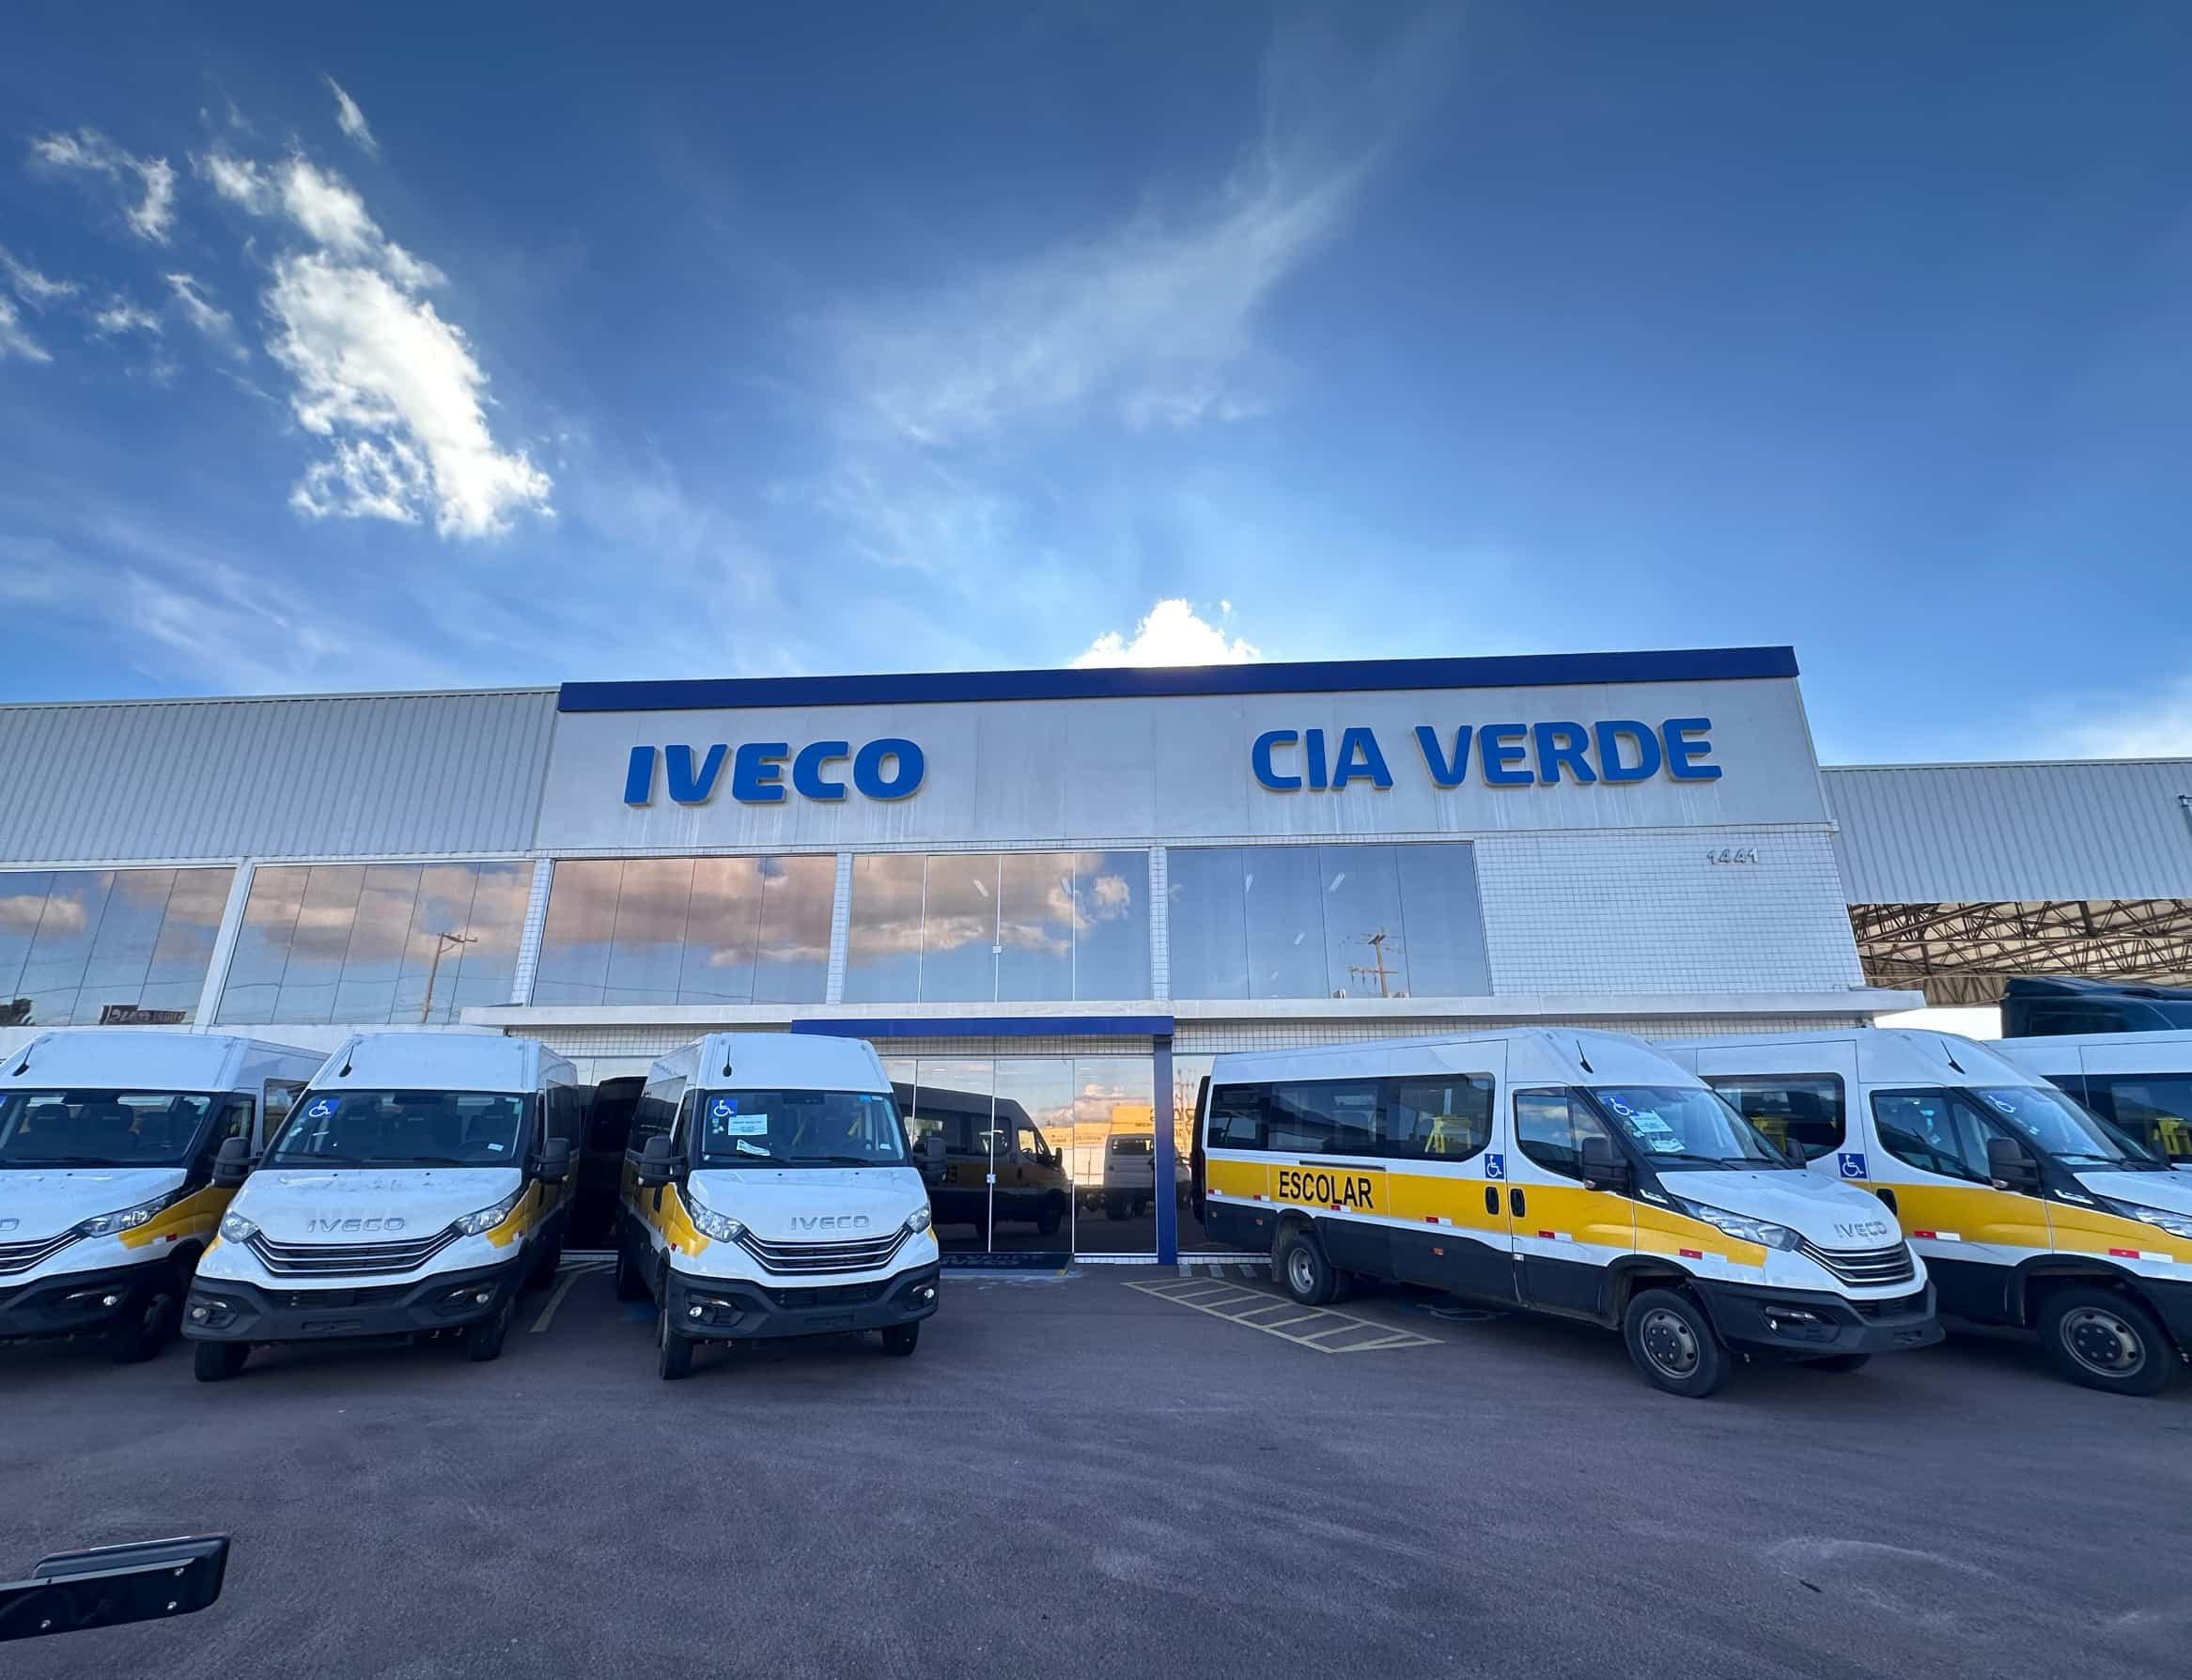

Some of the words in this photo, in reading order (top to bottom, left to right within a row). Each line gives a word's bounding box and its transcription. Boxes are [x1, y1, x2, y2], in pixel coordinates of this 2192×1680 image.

[1251, 727, 1394, 790] CIA
[1414, 717, 1722, 788] VERDE
[623, 738, 925, 807] IVECO
[1706, 848, 1759, 864] 1441
[1279, 1171, 1374, 1209] ESCOLAR
[307, 1218, 405, 1233] IVECO
[790, 1216, 869, 1230] IVECO
[1833, 1221, 1888, 1237] IVECO
